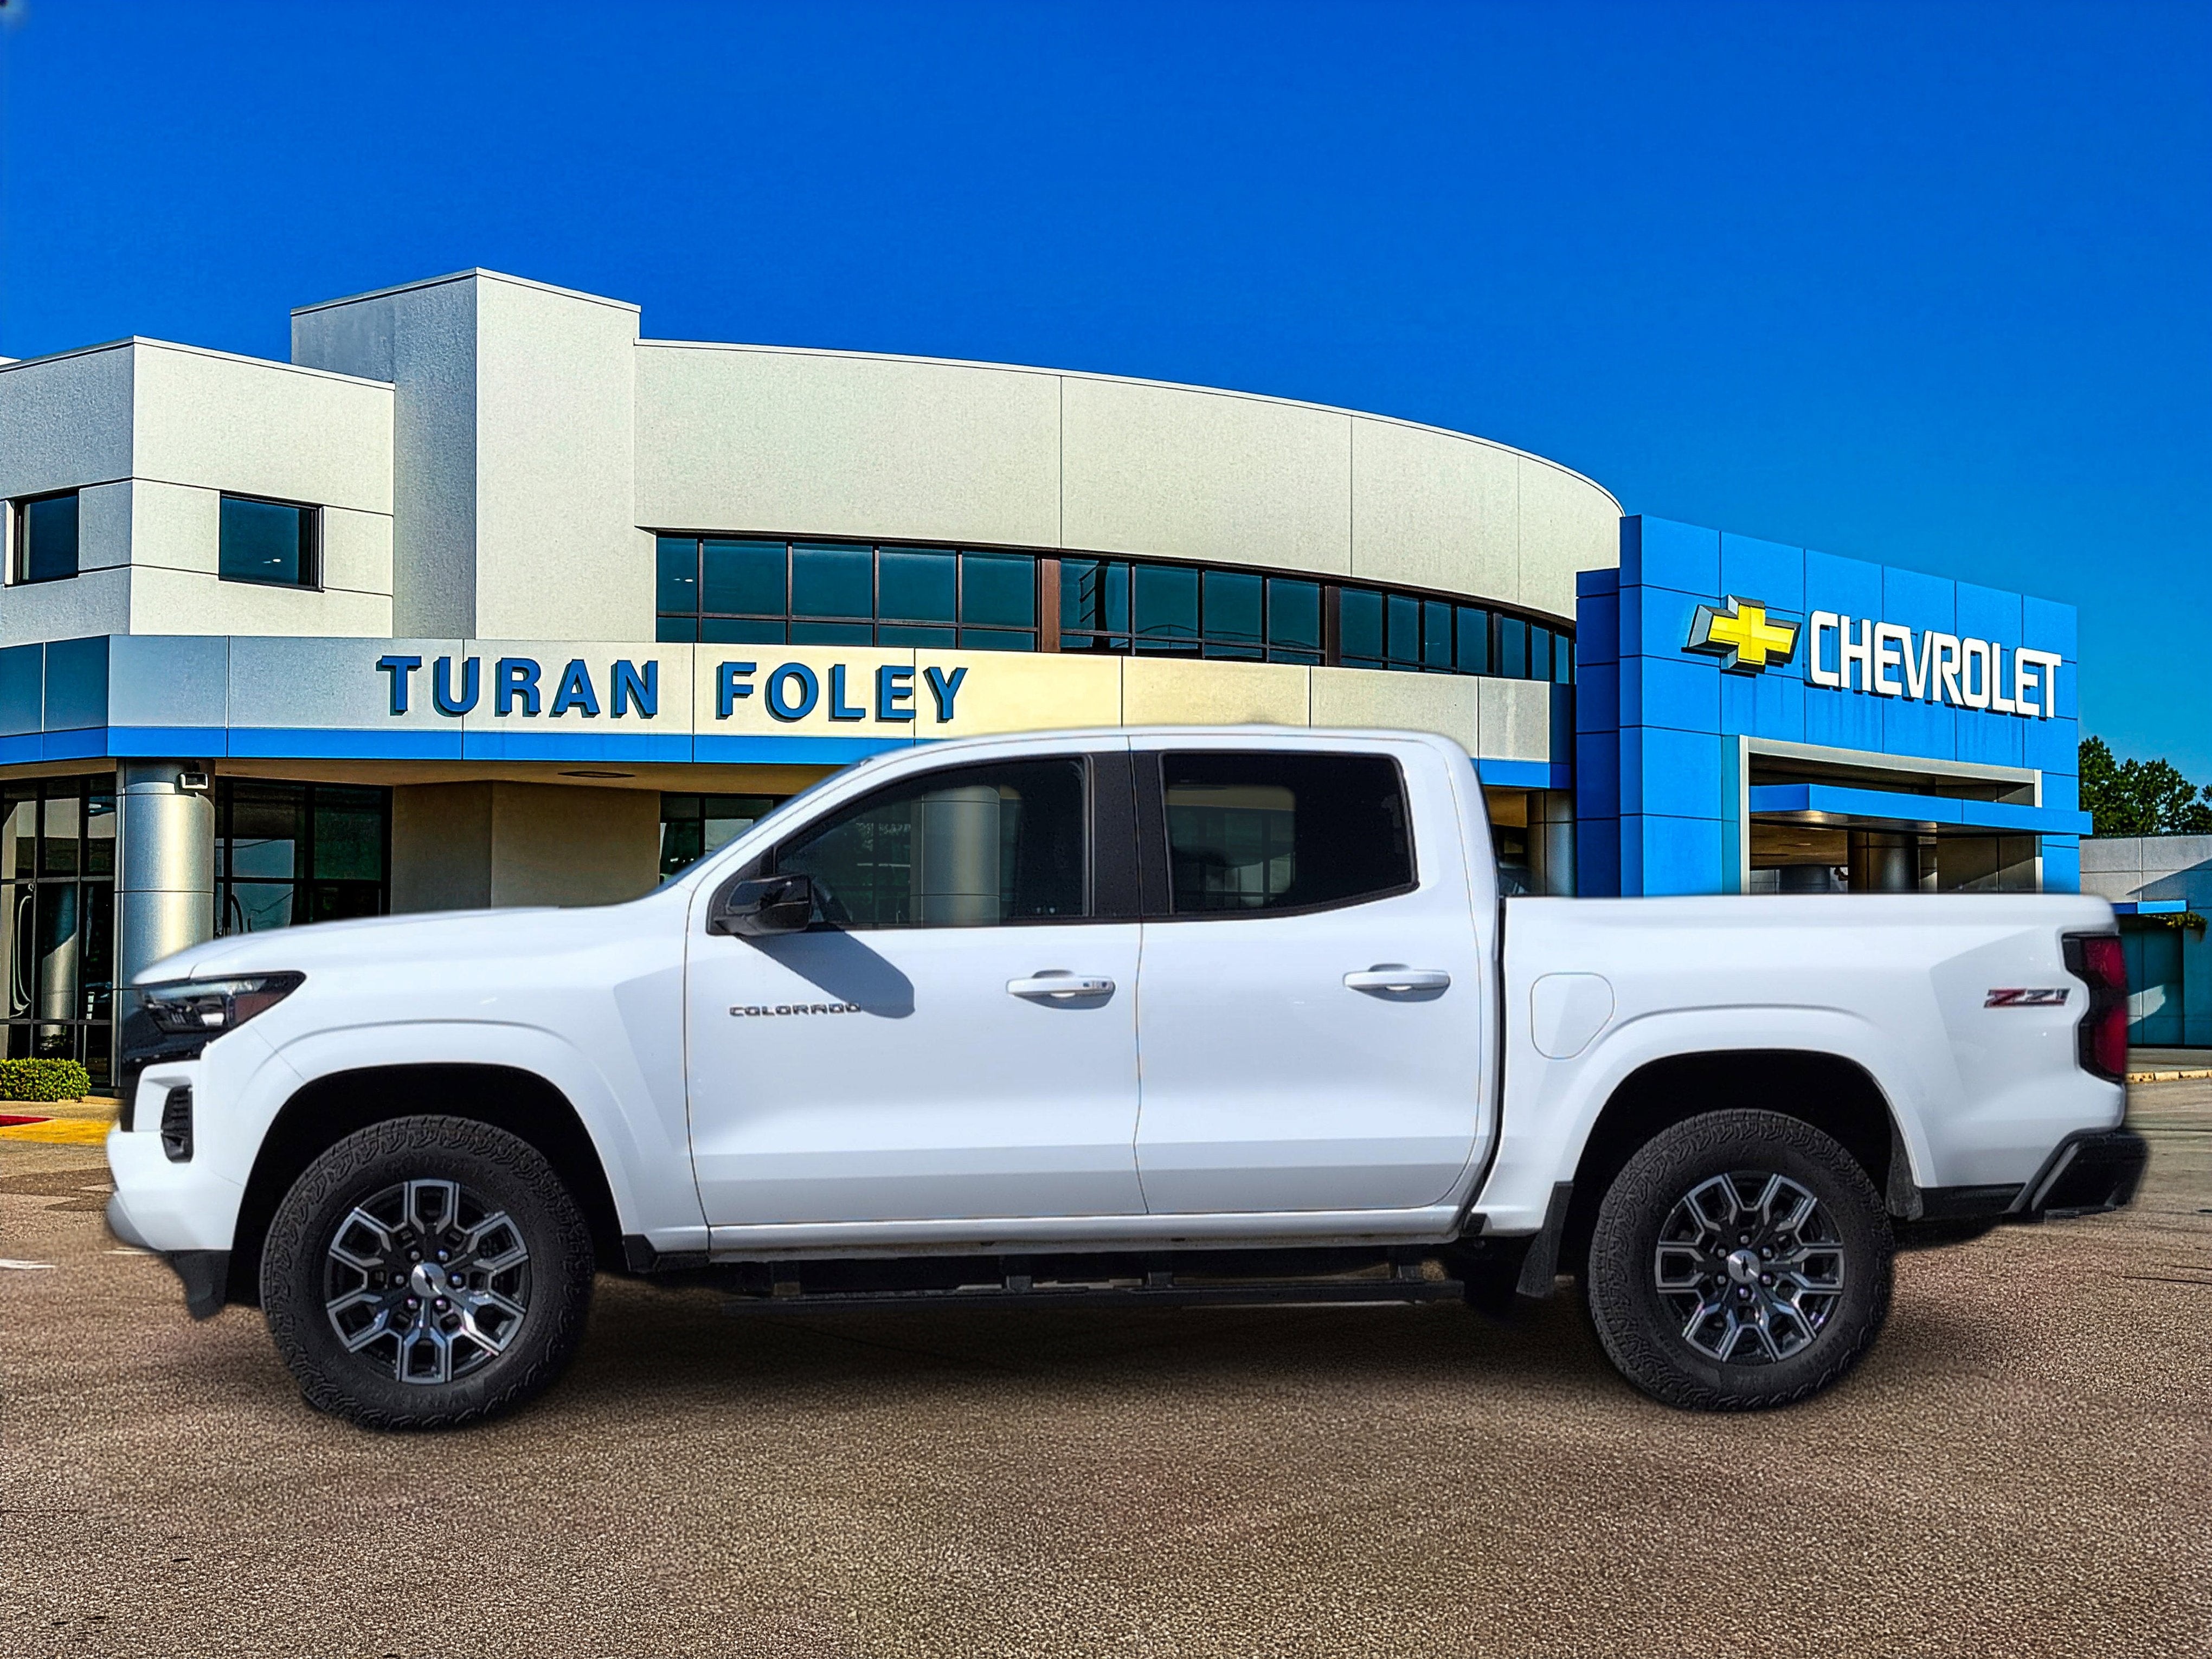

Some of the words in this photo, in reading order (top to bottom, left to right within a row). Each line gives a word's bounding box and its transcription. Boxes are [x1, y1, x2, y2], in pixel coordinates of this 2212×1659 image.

[1810, 610, 2062, 718] CHEVROLET
[376, 655, 659, 718] TURAN
[717, 661, 968, 723] FOLEY
[730, 1002, 861, 1017] COLORADO
[1984, 988, 2070, 1008] Z71
